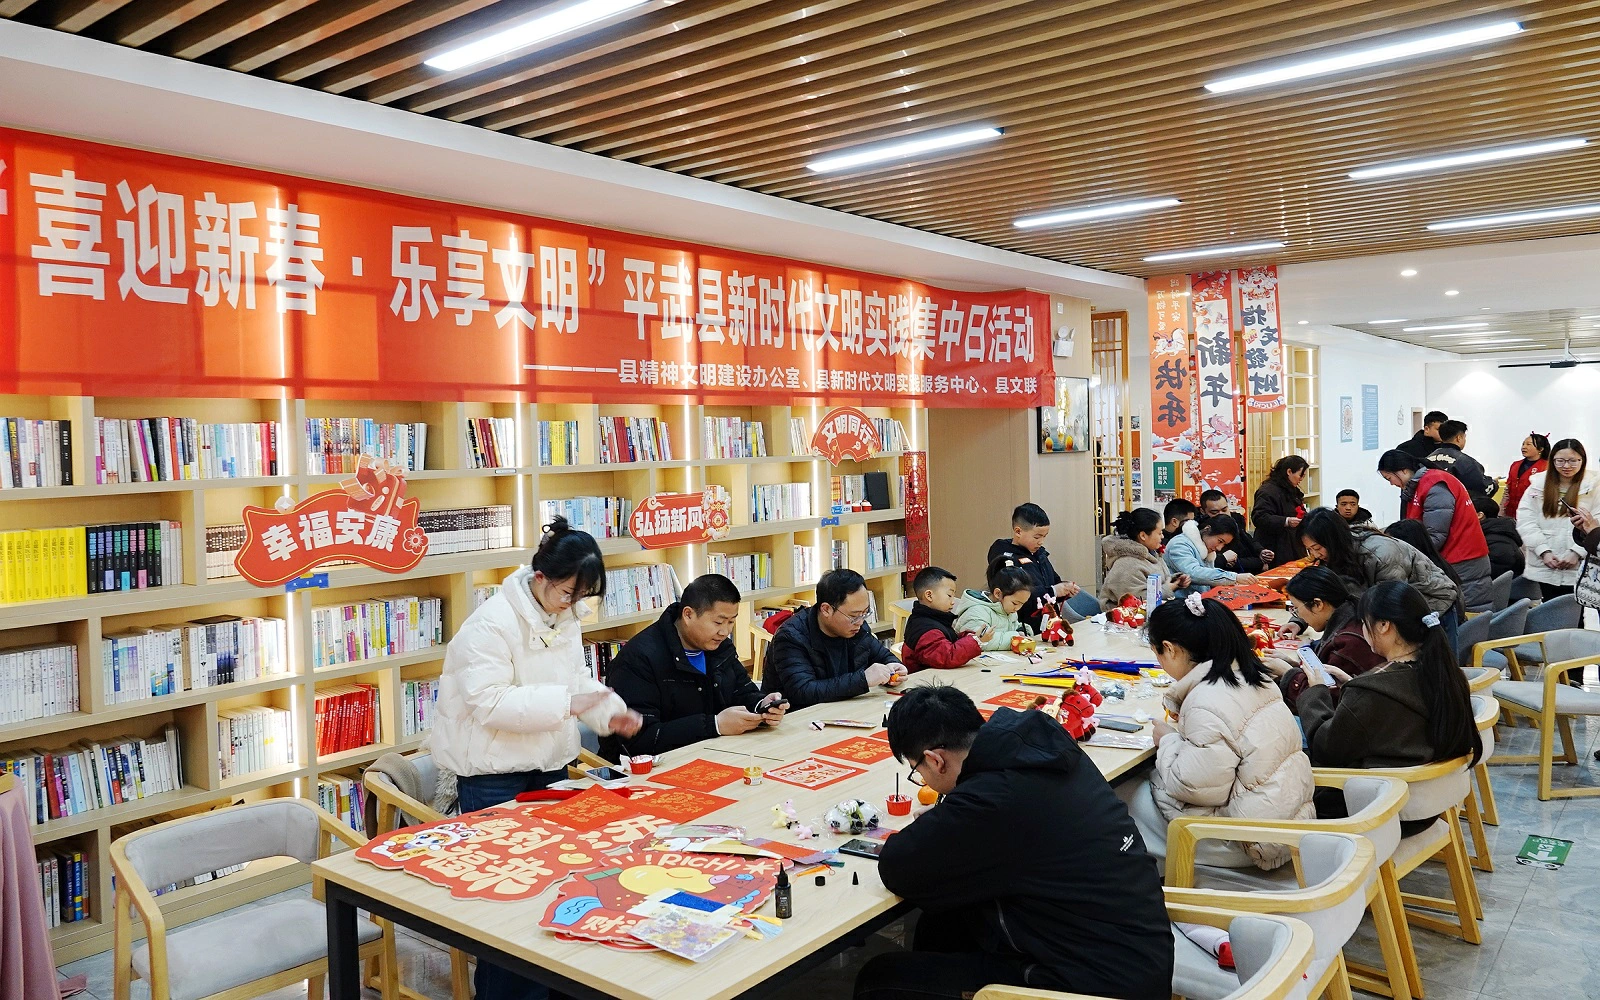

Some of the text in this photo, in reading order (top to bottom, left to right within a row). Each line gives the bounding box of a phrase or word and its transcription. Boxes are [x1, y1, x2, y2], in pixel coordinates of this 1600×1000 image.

[821, 414, 873, 444] 文明同行
[261, 509, 401, 561] 幸福安康
[636, 506, 704, 537] 弘扬新风
[419, 844, 553, 894] 福来
